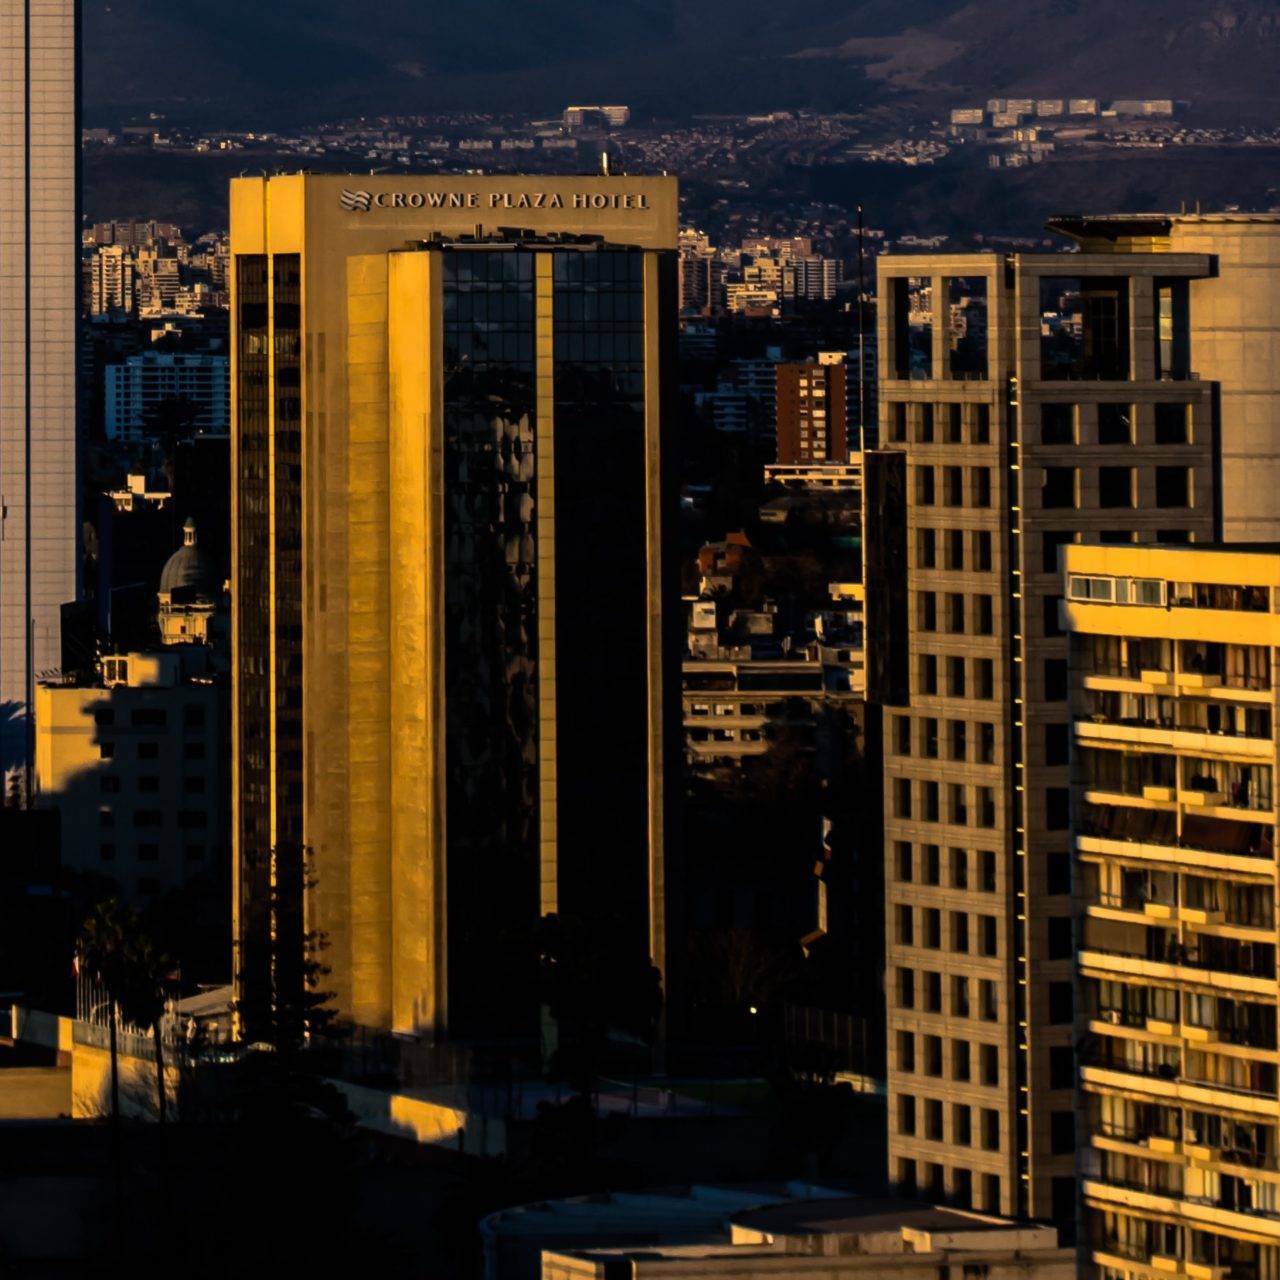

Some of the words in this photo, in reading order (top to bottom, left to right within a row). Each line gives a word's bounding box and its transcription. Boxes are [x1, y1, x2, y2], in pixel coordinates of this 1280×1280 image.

[375, 192, 480, 208] CROWNE
[489, 192, 563, 208] PLAZA
[573, 193, 650, 209] HOTEL
